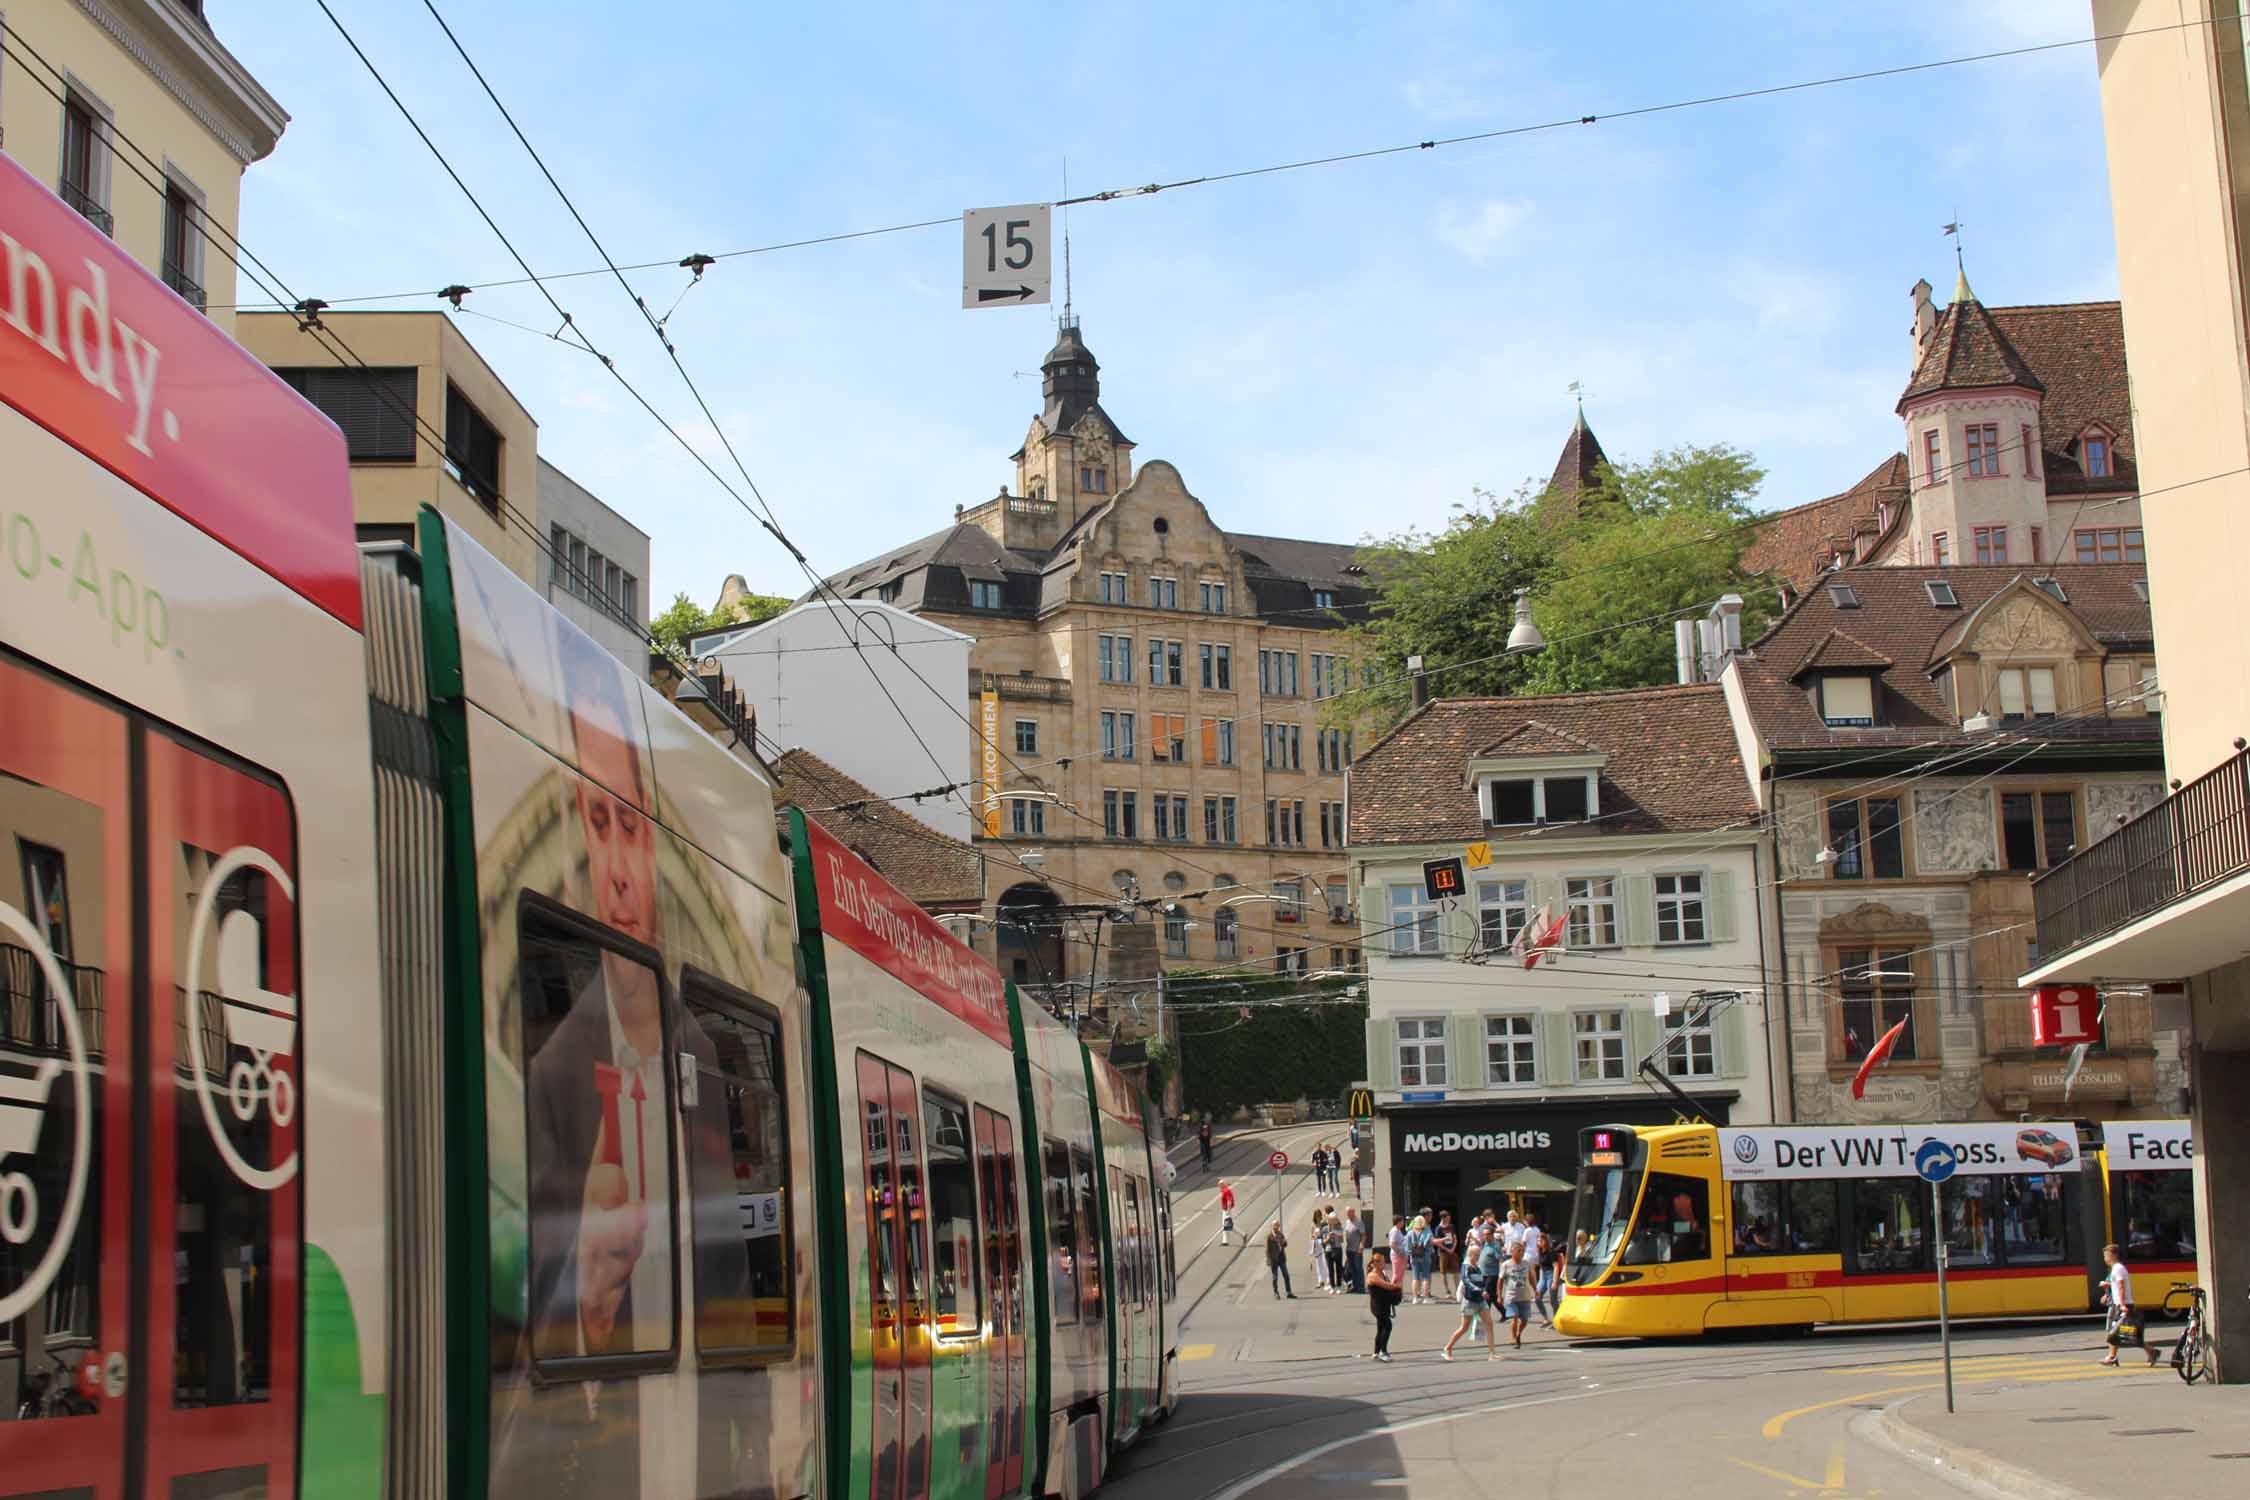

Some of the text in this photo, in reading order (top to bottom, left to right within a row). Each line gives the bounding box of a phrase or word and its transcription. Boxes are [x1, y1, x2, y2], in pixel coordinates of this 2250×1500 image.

[981, 219, 1033, 272] 15
[827, 851, 862, 922] Ein
[859, 878, 913, 960] Service
[911, 916, 935, 974] der
[2052, 990, 2088, 1038] i
[1404, 1130, 1551, 1152] McDonald's
[1774, 1137, 2005, 1168] Der VW T-oss.
